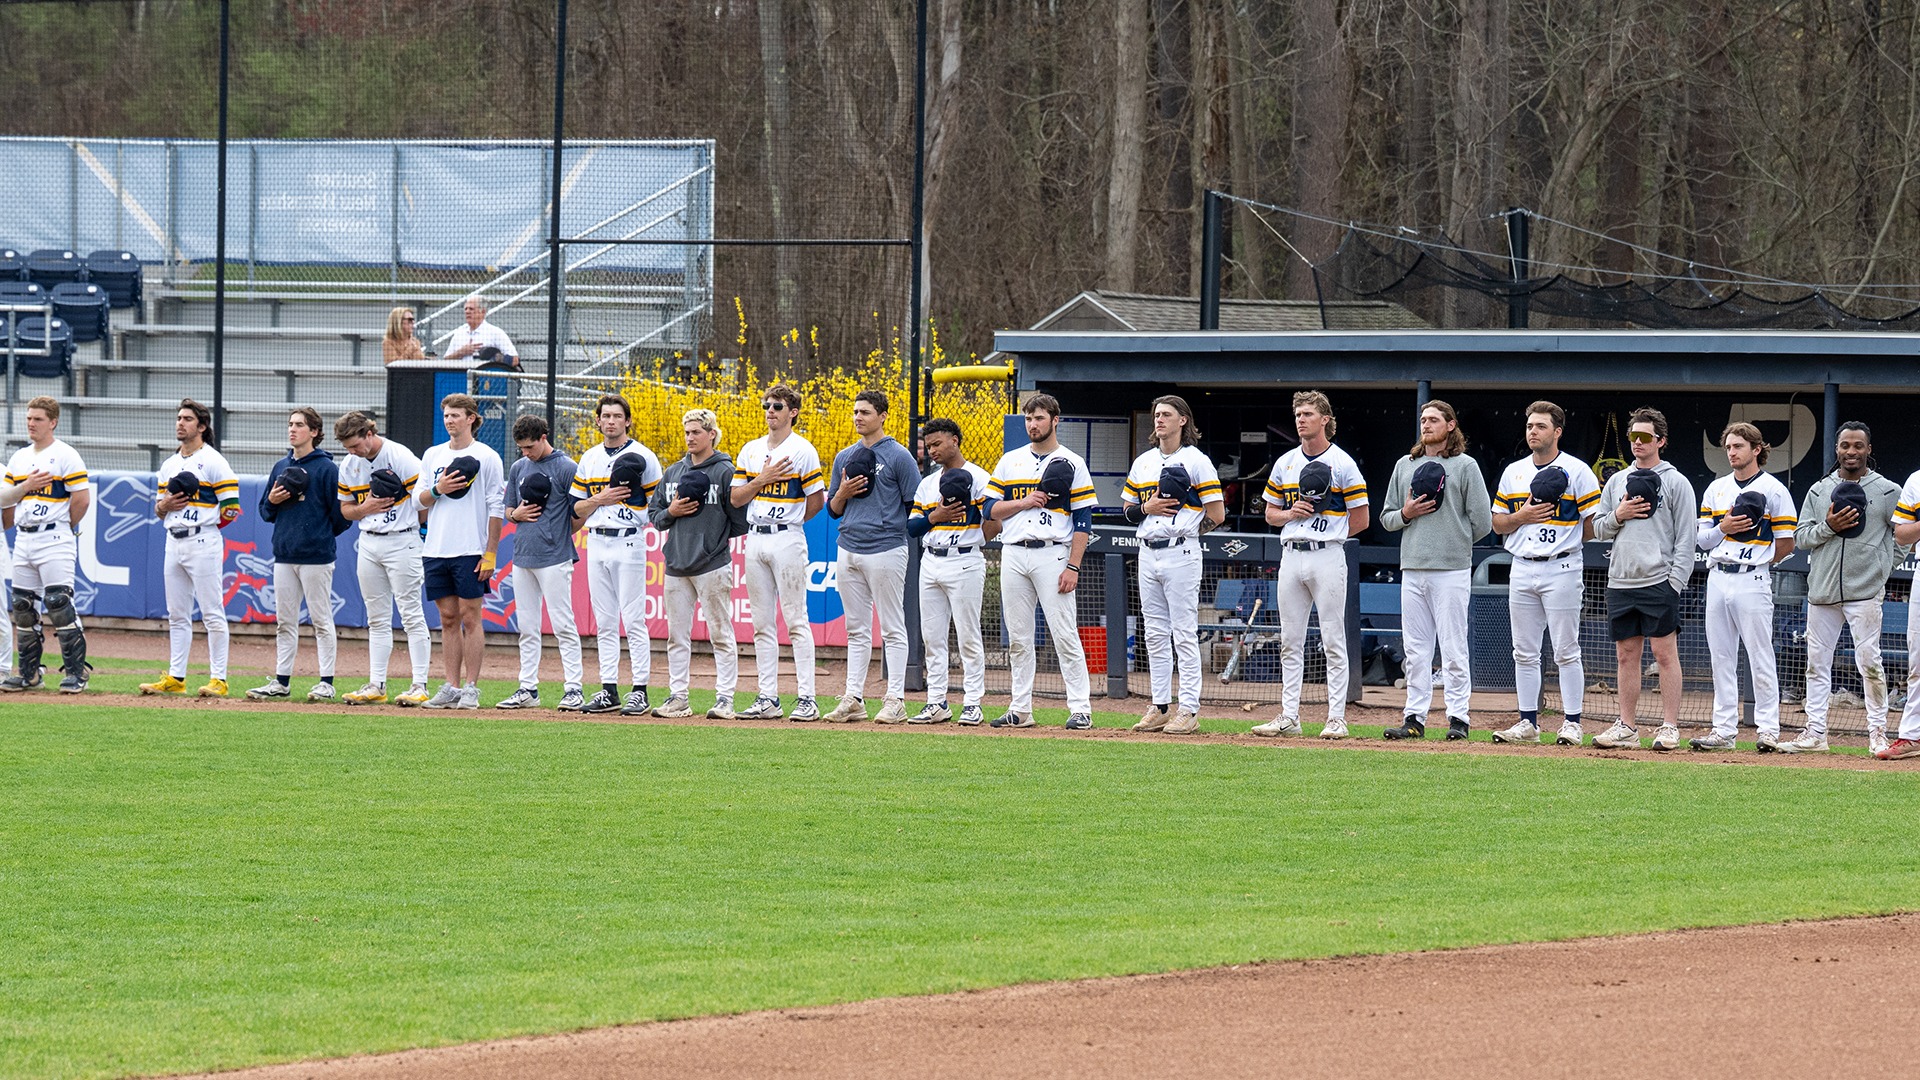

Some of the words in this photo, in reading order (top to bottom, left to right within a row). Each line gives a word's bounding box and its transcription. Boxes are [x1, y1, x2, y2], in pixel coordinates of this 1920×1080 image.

[33, 503, 49, 516] 20
[183, 509, 198, 522] 44
[383, 509, 397, 523] 35
[617, 508, 633, 521] 43
[767, 506, 785, 519] 42
[1311, 517, 1328, 532] 40
[1539, 528, 1556, 543] 33
[1739, 547, 1753, 560] 14
